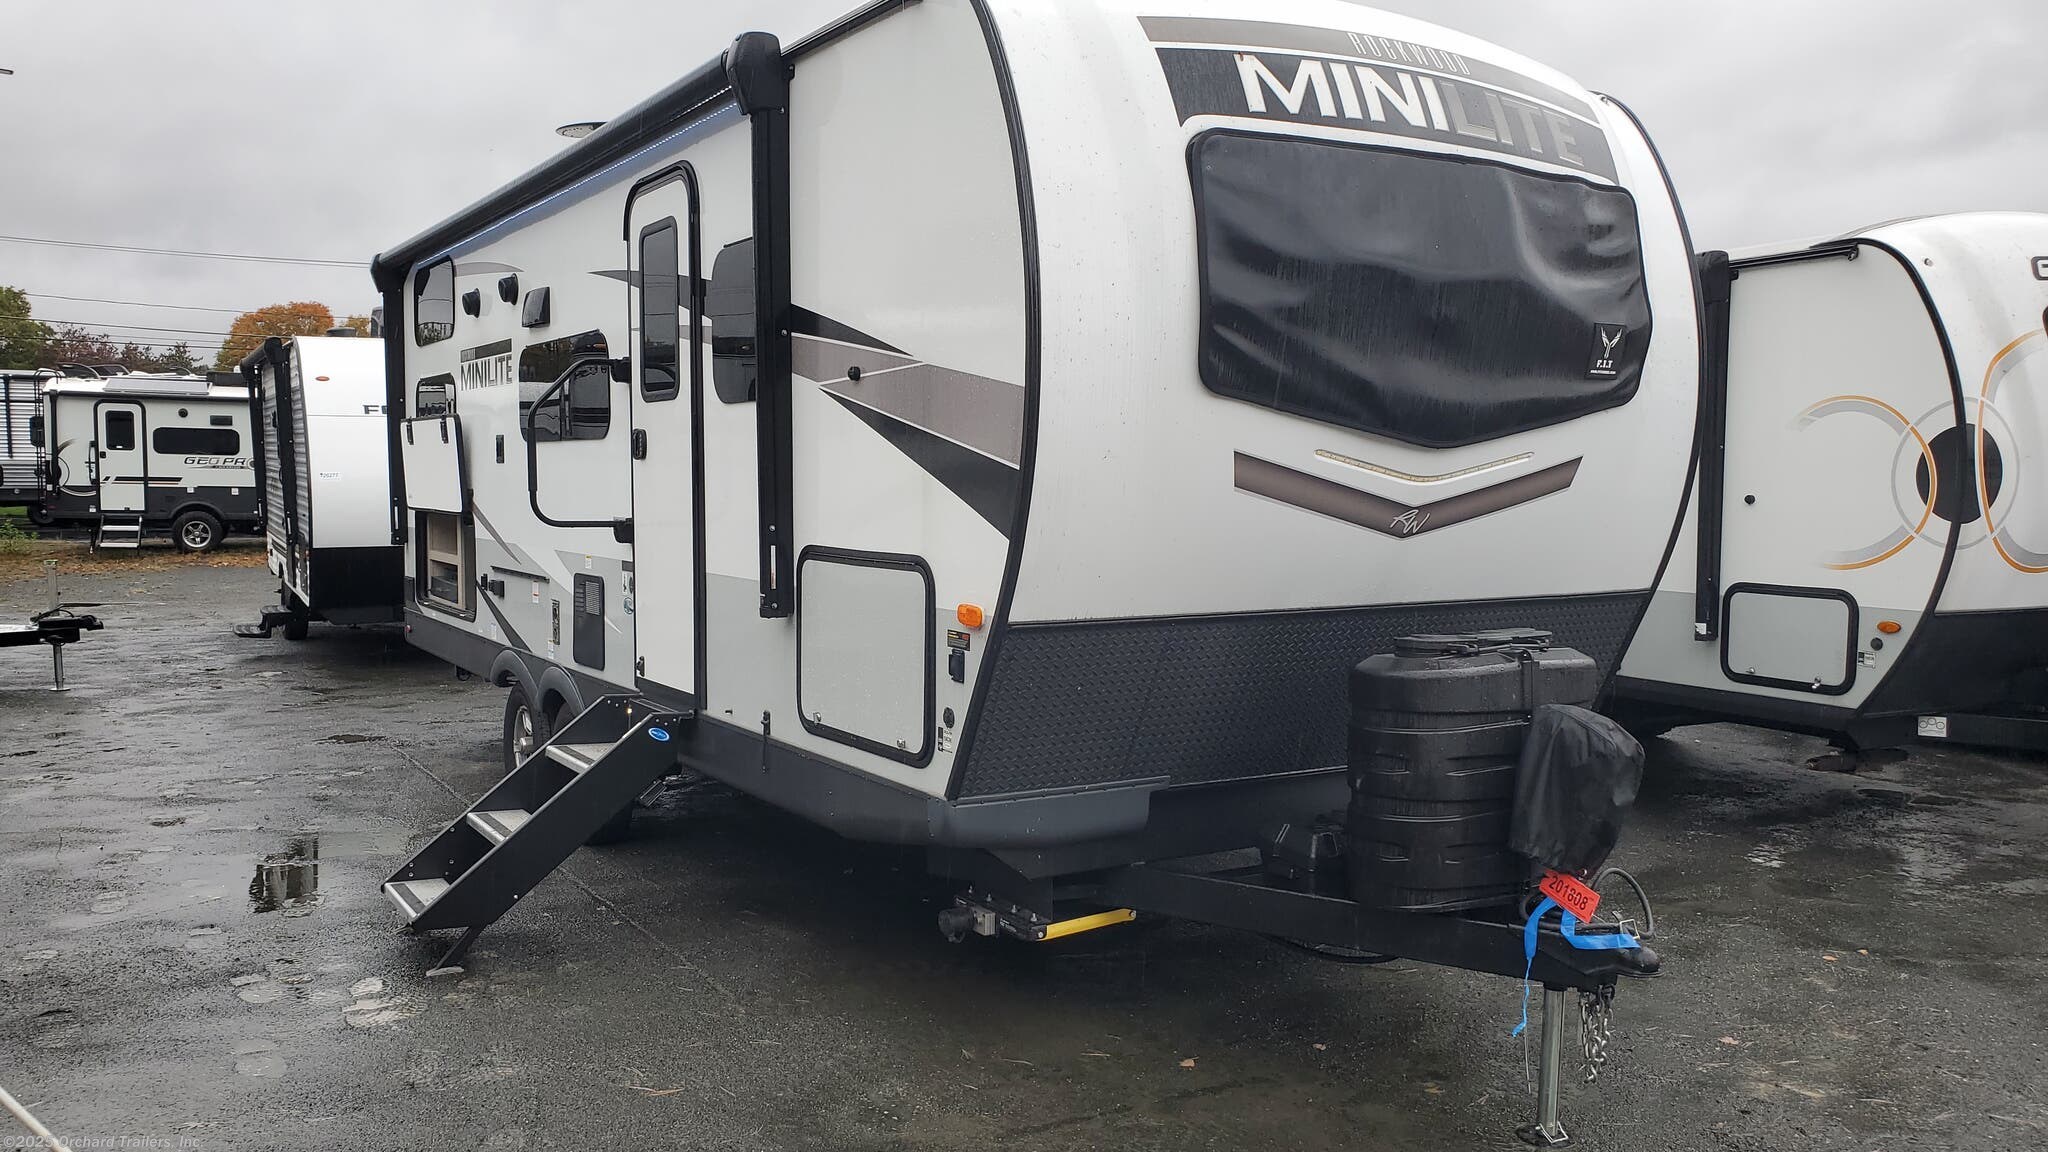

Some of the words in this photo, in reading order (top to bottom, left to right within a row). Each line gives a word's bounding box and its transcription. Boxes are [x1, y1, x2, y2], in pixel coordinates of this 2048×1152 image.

[1346, 31, 1472, 76] ROCKWOOD
[460, 354, 513, 391] MINILITE
[184, 456, 219, 465] GEO
